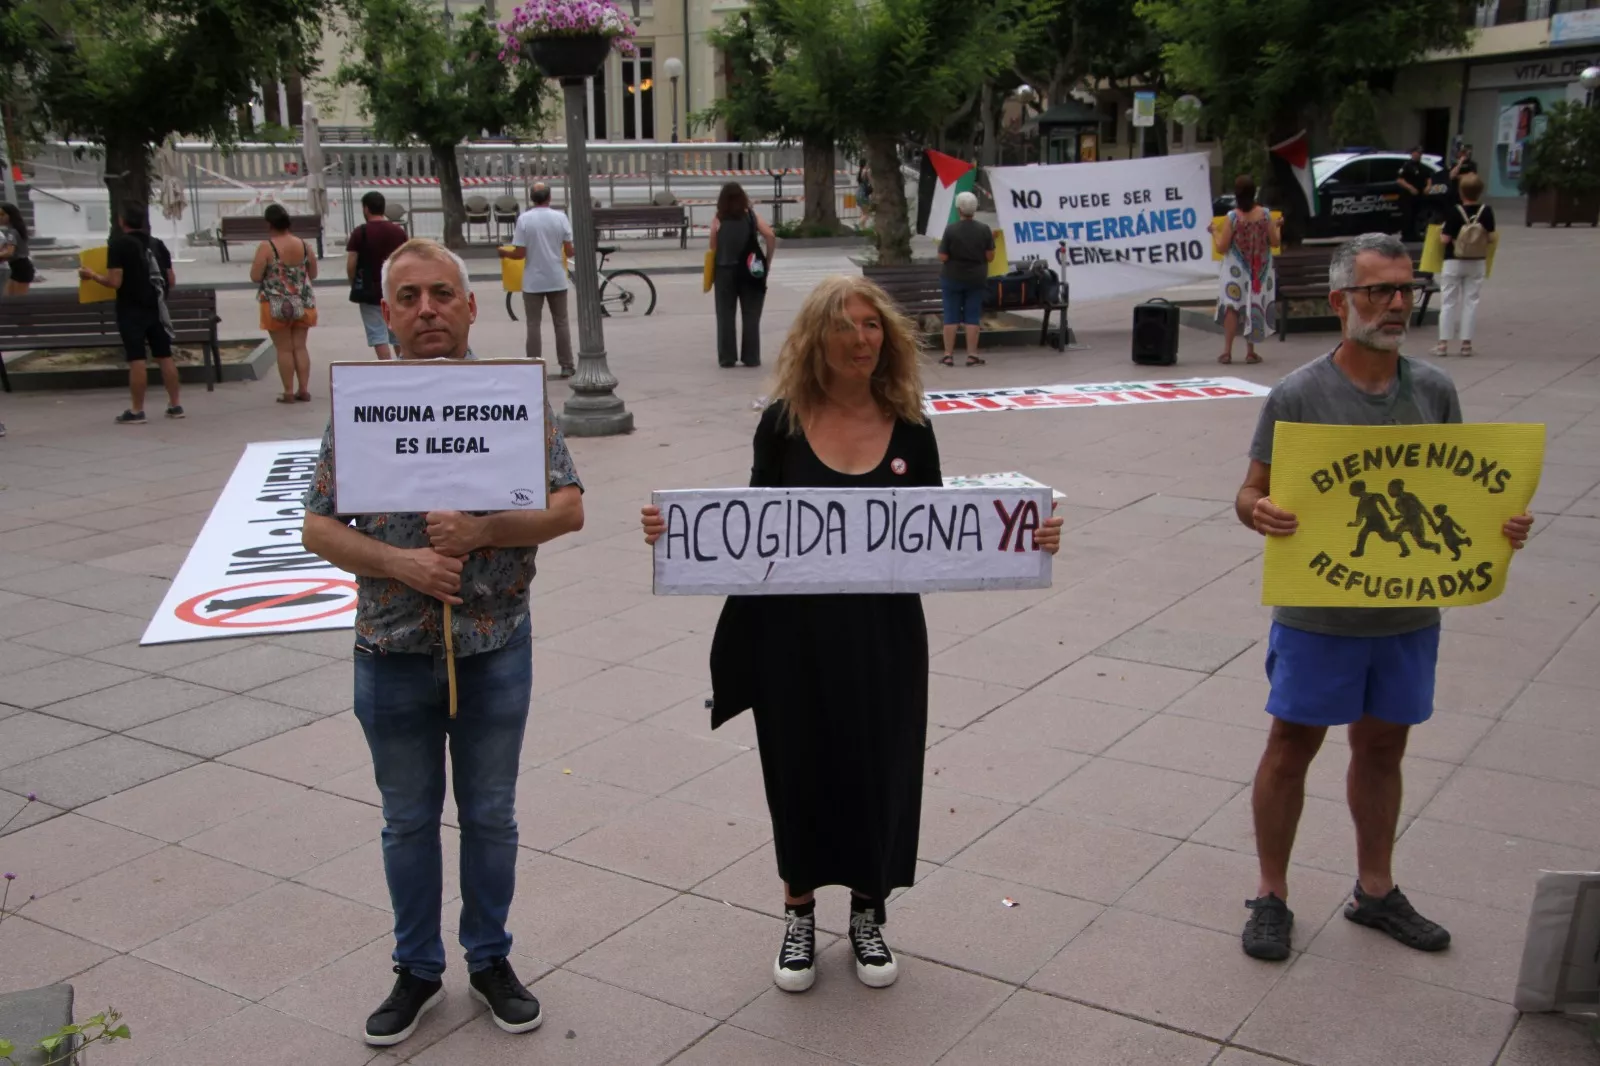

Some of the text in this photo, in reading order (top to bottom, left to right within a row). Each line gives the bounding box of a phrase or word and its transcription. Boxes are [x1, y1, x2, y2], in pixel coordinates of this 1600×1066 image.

[1010, 187, 1183, 209] NO PUEDE SER EL
[1331, 204, 1400, 215] NACIONAL
[1013, 207, 1197, 244] MEDITERRÁNEO
[1055, 240, 1204, 267] CEMENTERIO
[929, 386, 1254, 413] ALESTINA
[353, 404, 529, 423] NINGUNA PERSONA
[395, 437, 490, 455] ES ILEGAL
[1310, 442, 1512, 494] BIENVENIDXS
[667, 499, 1040, 562] ACOGIDA DIGNA YA
[1309, 550, 1493, 602] REFUGIADXS
